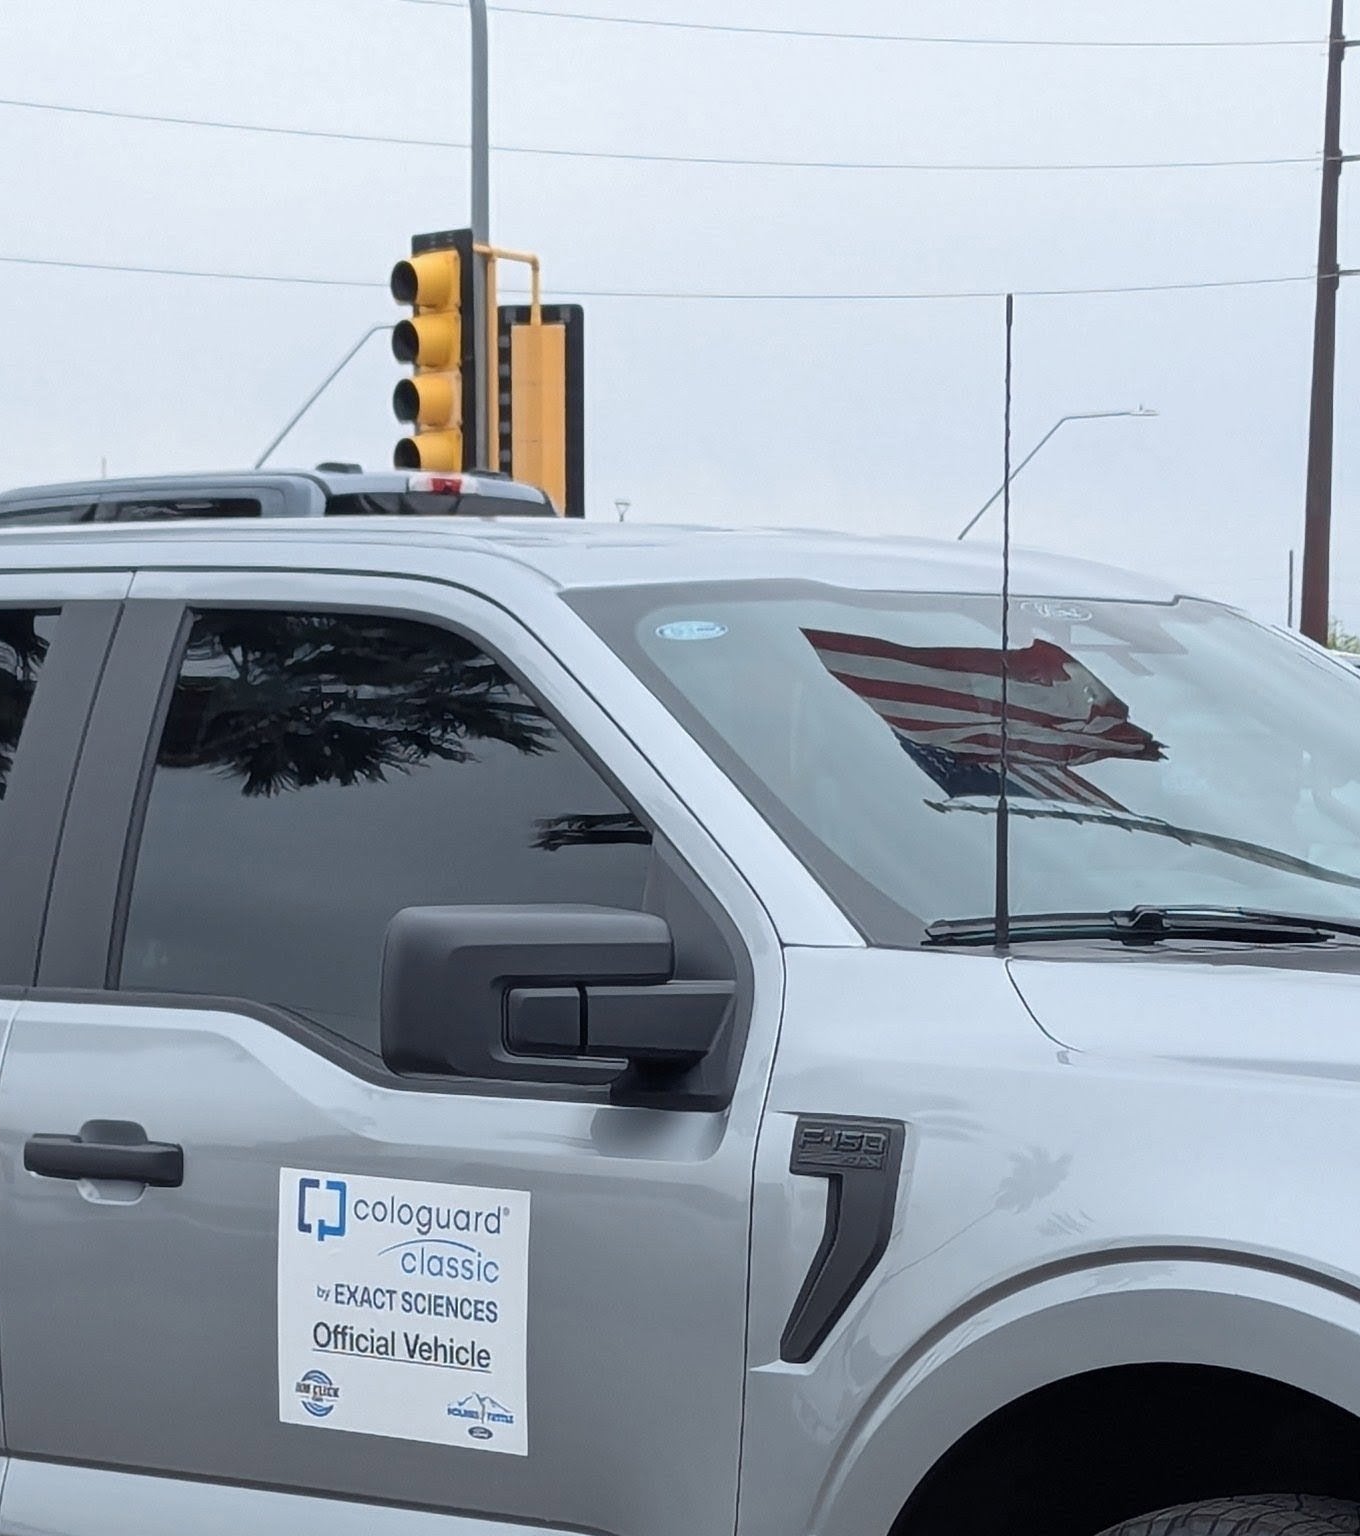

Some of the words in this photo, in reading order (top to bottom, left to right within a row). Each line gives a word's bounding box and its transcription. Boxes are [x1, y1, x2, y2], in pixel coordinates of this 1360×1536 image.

[401, 1247, 500, 1283] classic
[316, 1285, 330, 1301] by
[334, 1284, 397, 1311] EXACT
[401, 1291, 498, 1323] SCIENCES
[313, 1321, 395, 1356] Official
[403, 1331, 491, 1368] Vehicle
